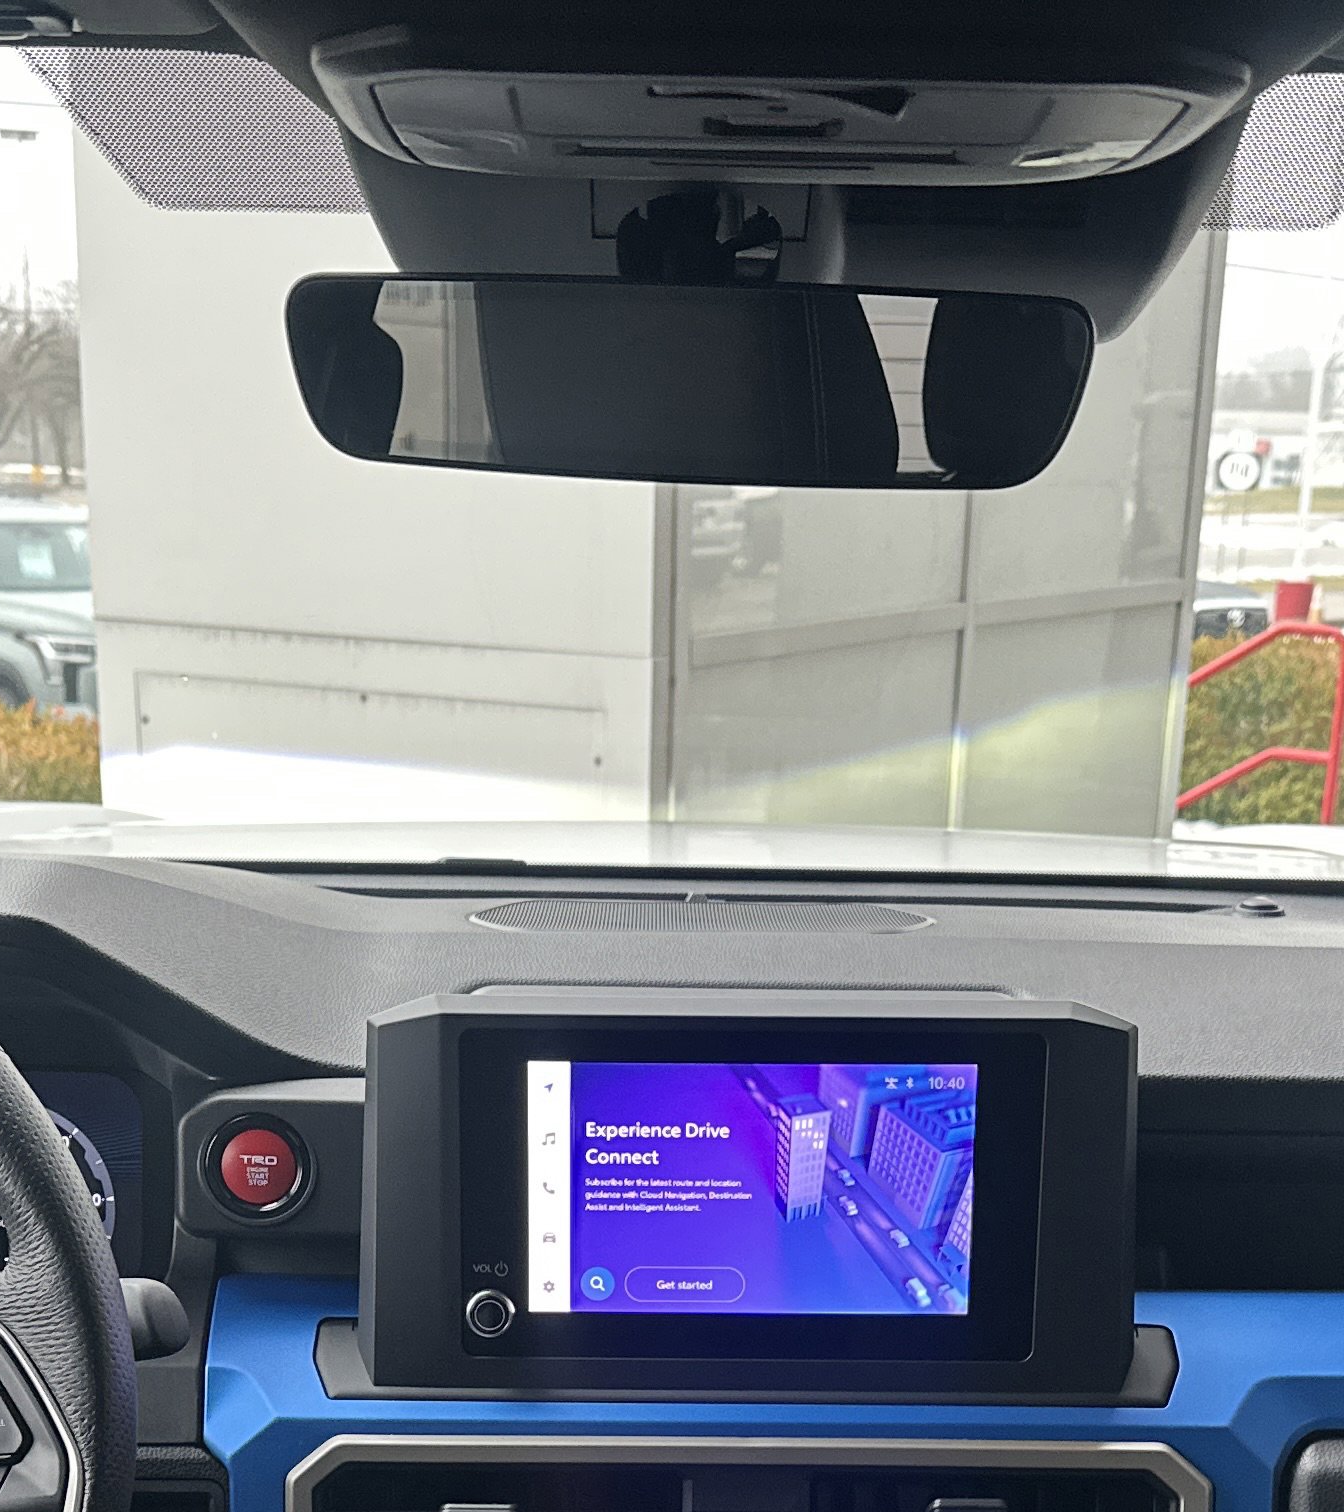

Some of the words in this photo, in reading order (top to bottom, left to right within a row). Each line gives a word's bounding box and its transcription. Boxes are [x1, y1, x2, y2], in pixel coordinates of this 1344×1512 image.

[928, 1076, 966, 1090] 10:40
[585, 1121, 682, 1142] Experience
[685, 1121, 731, 1139] Drive
[239, 1154, 278, 1166] TRD
[585, 1147, 660, 1165] Connect
[585, 1177, 623, 1187] Subscribe
[624, 1177, 635, 1187] for
[636, 1178, 649, 1187] the
[650, 1178, 672, 1187] latest
[695, 1179, 710, 1187] and
[711, 1179, 742, 1188] location
[585, 1190, 621, 1200] guidance
[622, 1190, 639, 1199] with
[640, 1190, 663, 1199] Cloud
[664, 1190, 708, 1201] Navigation,
[709, 1191, 753, 1200] Destination
[585, 1203, 608, 1211] Assist
[608, 1203, 624, 1211] and
[625, 1203, 664, 1213] Intelligent
[473, 1263, 492, 1273] VOL
[656, 1279, 676, 1290] Get
[677, 1279, 714, 1290] started
